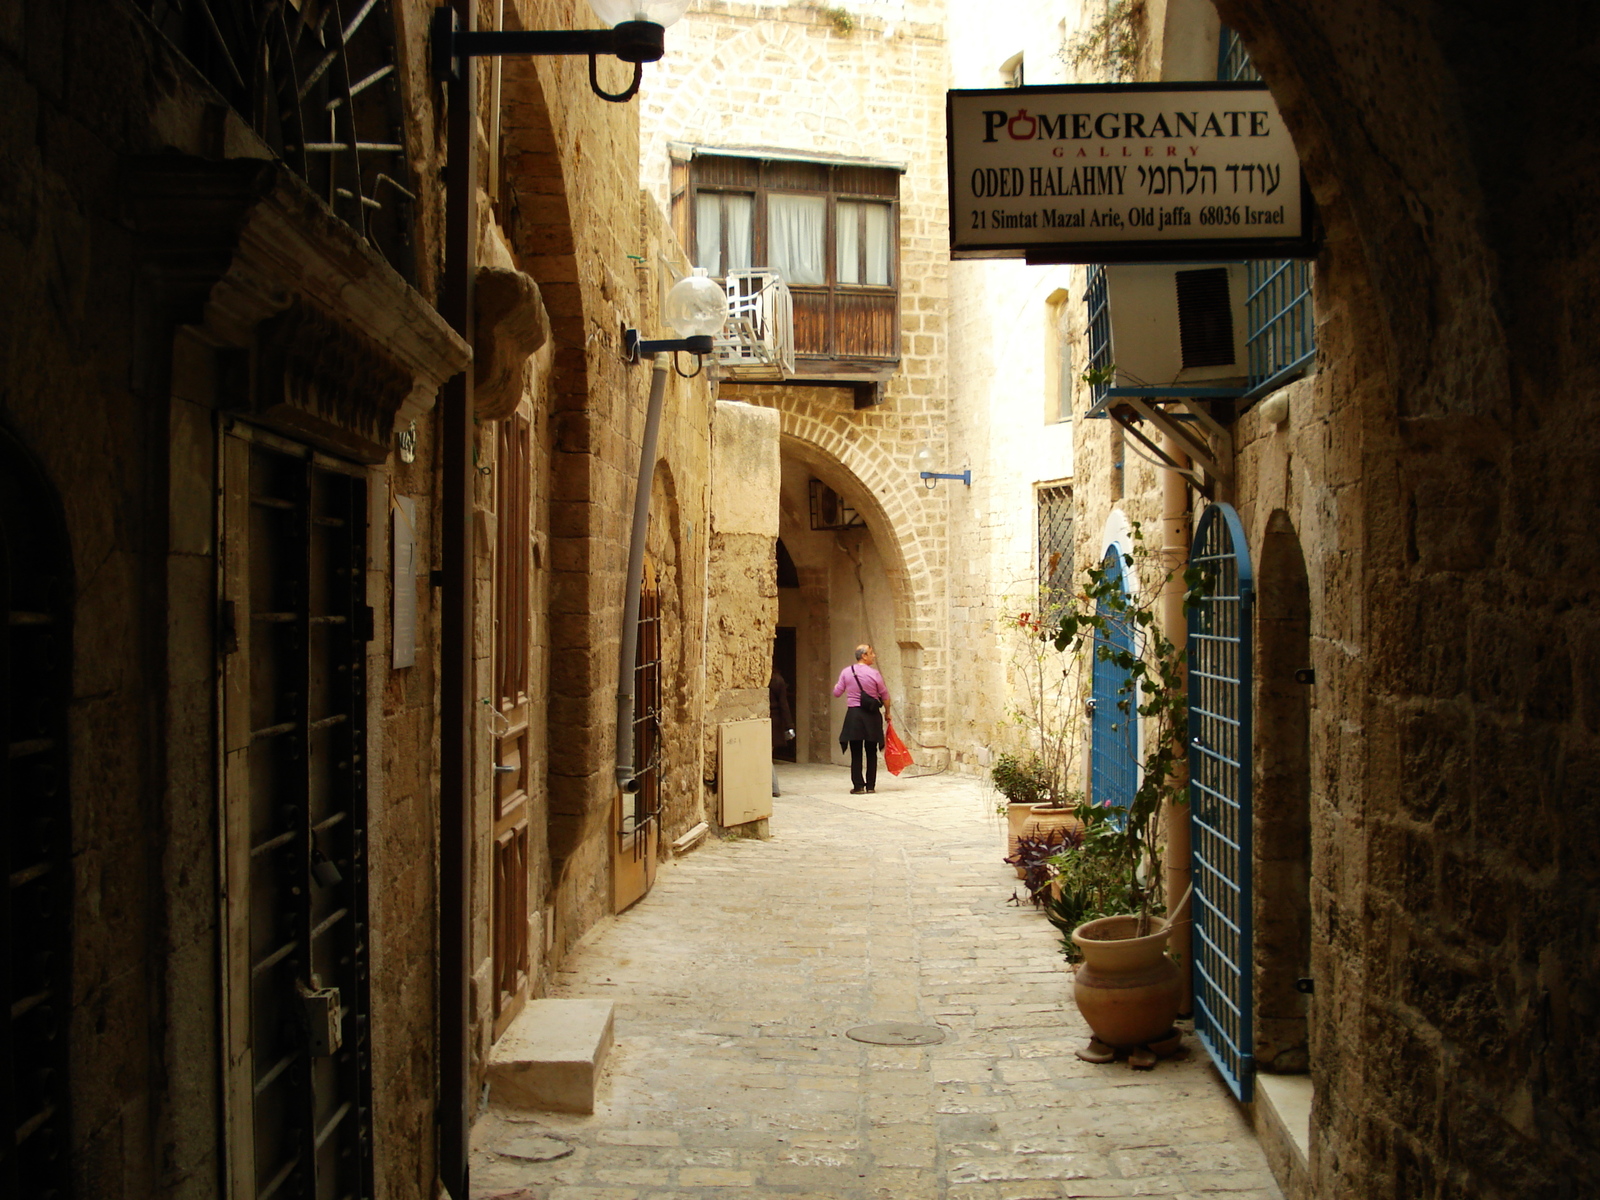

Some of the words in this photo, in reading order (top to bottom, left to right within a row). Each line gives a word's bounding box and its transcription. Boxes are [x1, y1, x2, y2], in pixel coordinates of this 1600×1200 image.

[982, 109, 1270, 143] POMEGRANATE
[1052, 145, 1200, 158] GALLERY
[971, 166, 1024, 198] ODED
[1029, 165, 1127, 197] HALAHMY
[1138, 157, 1217, 196] הלחמי
[1225, 163, 1281, 196] עודד
[971, 210, 987, 230] 21
[991, 209, 1038, 229] Simtat
[1042, 208, 1086, 229] Mazal
[1090, 208, 1125, 231] Arie,
[1128, 207, 1154, 228] Old
[1158, 205, 1192, 232] jaffa
[1199, 206, 1241, 226] 68036
[1245, 205, 1285, 225] Israel
